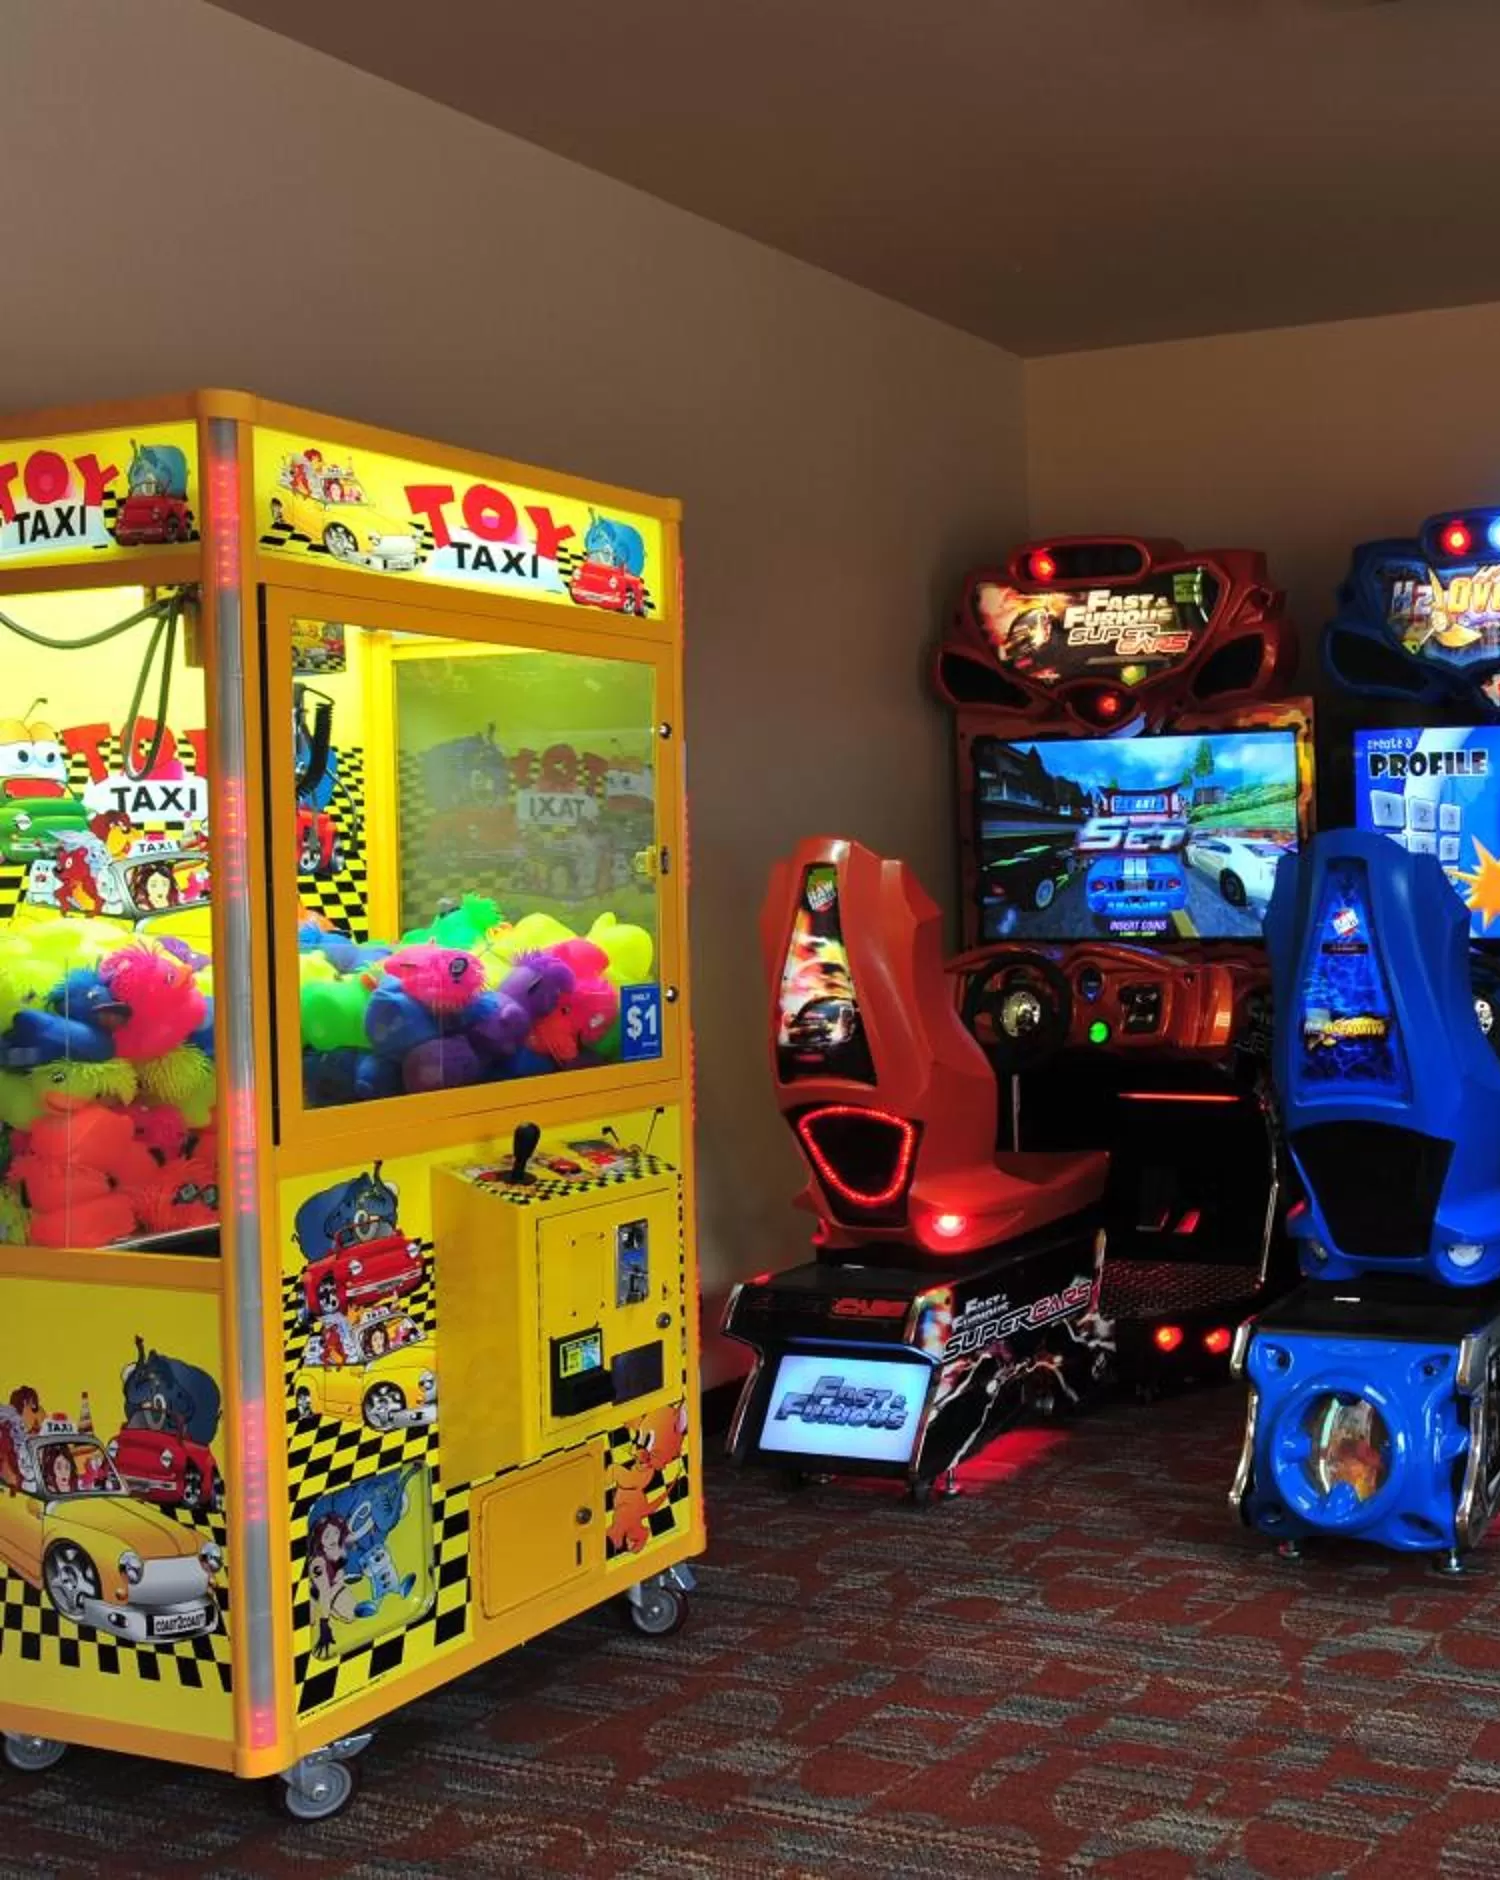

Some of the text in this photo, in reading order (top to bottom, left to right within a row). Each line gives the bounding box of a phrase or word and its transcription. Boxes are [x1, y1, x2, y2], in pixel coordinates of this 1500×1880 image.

[14, 505, 86, 544] TAXI
[404, 484, 575, 561] TOY
[450, 542, 539, 578] TAXI
[1087, 590, 1154, 612] FAST
[1064, 606, 1173, 628] FURIOUS
[1067, 624, 1160, 646] SUPER
[1115, 631, 1192, 654] CARS
[1367, 739, 1402, 749] create
[1368, 749, 1488, 778] PROFILE
[110, 786, 197, 813] TAXI
[1078, 816, 1186, 849] SET
[139, 842, 174, 854] TAXI
[627, 1005, 656, 1040] $1
[952, 1301, 1010, 1331] FURIOUS
[965, 1294, 1000, 1315] FAST
[813, 1376, 893, 1407] FAST
[774, 1392, 908, 1430] FURIOUS
[46, 1421, 73, 1432] TAXI
